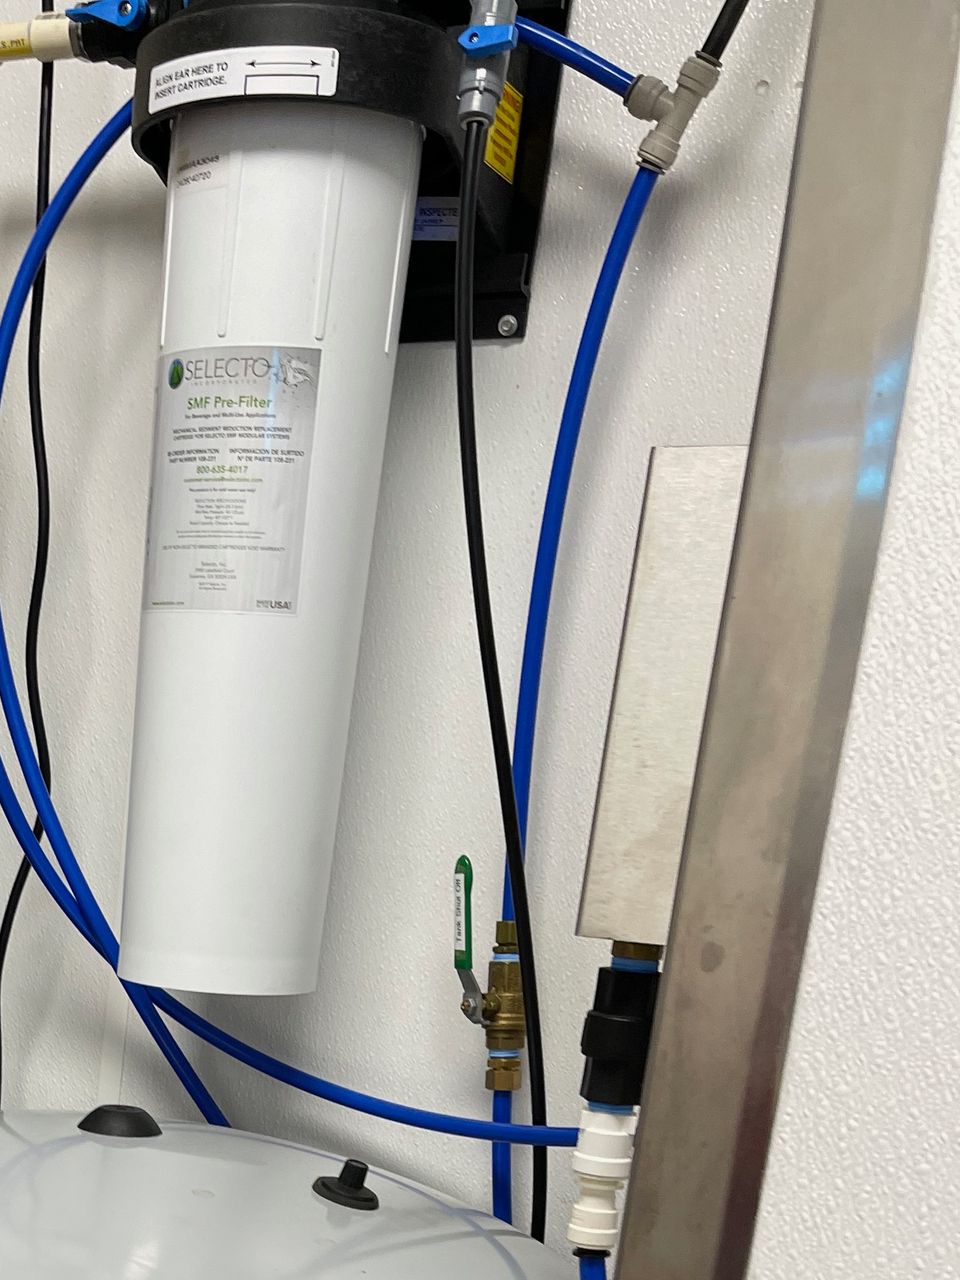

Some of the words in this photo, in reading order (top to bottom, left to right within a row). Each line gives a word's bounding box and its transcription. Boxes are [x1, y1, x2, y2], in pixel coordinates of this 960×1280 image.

[174, 68, 190, 81] EAR
[191, 63, 214, 77] HERE
[216, 61, 228, 72] TO
[184, 357, 271, 382] SELECTO
[187, 395, 210, 410] SMF
[214, 394, 272, 408] Pre-Filter
